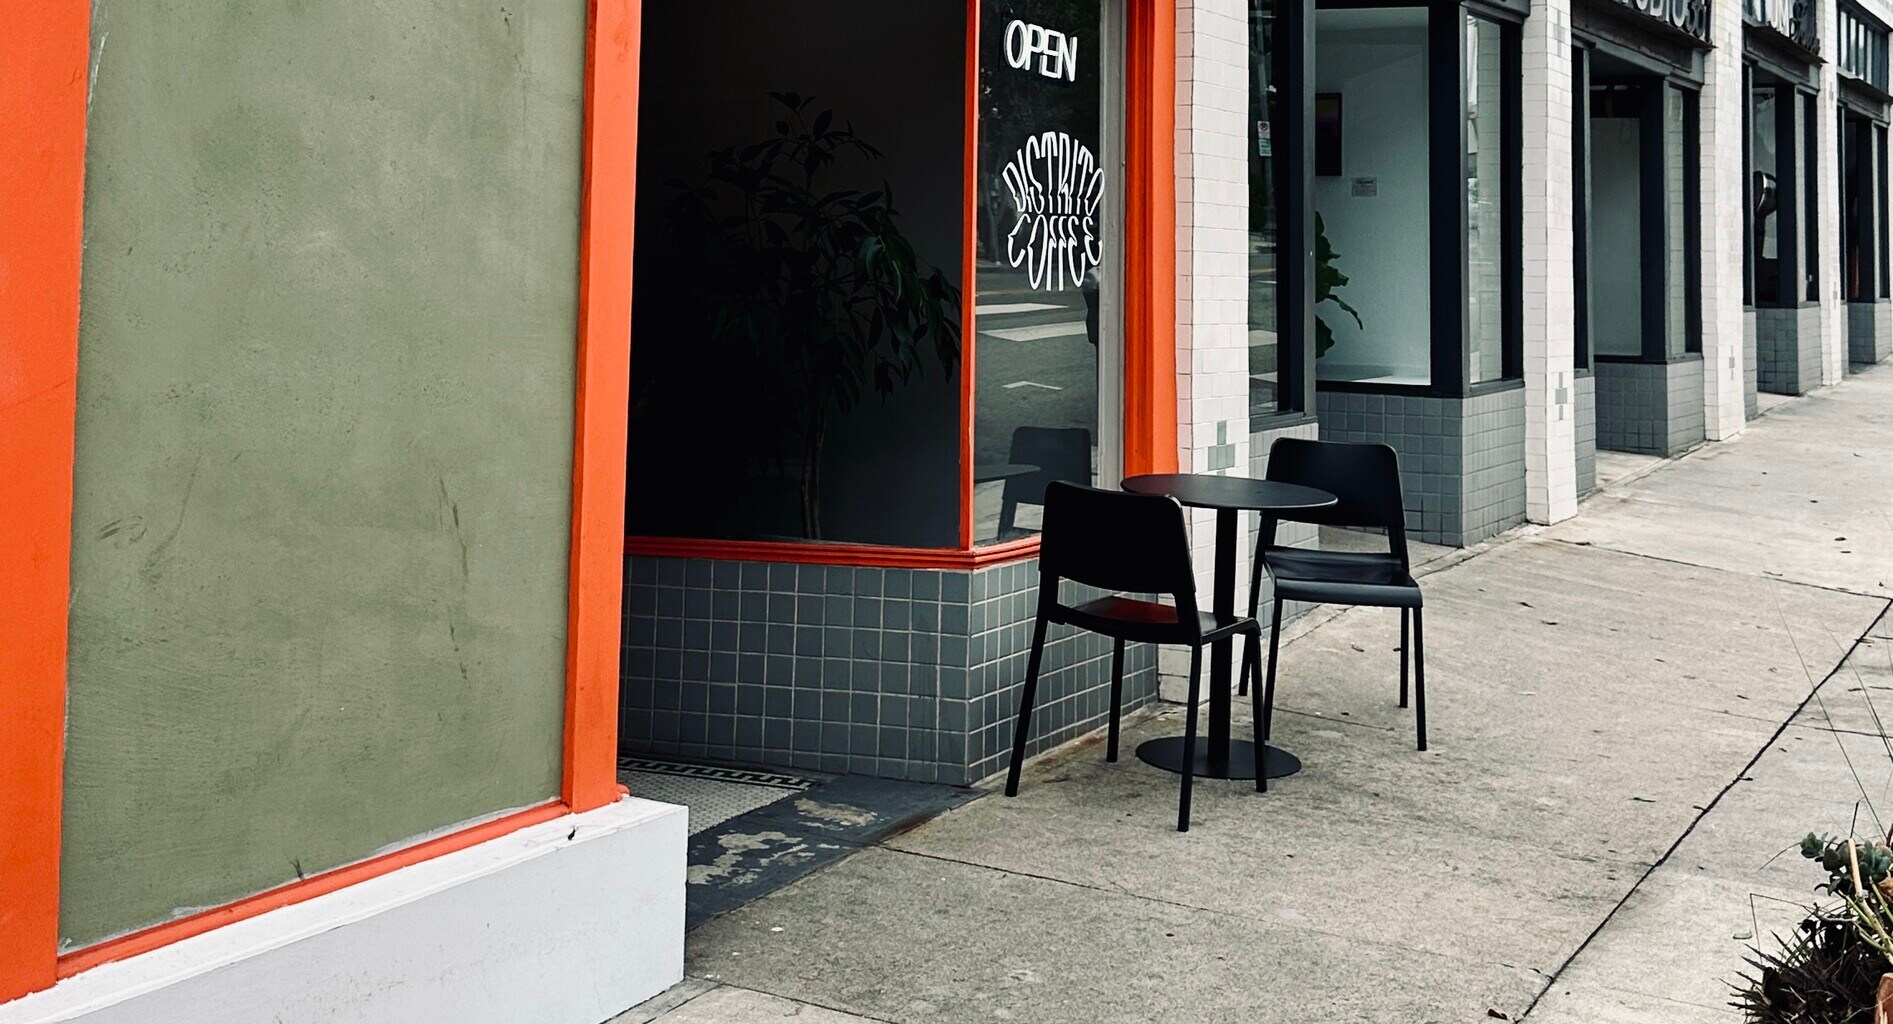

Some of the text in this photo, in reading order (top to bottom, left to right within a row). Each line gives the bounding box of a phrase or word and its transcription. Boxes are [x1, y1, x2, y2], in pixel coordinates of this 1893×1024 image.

[1004, 19, 1078, 82] OPEN
[1002, 131, 1105, 215] DISTRITO
[1007, 213, 1103, 291] COFFEE
